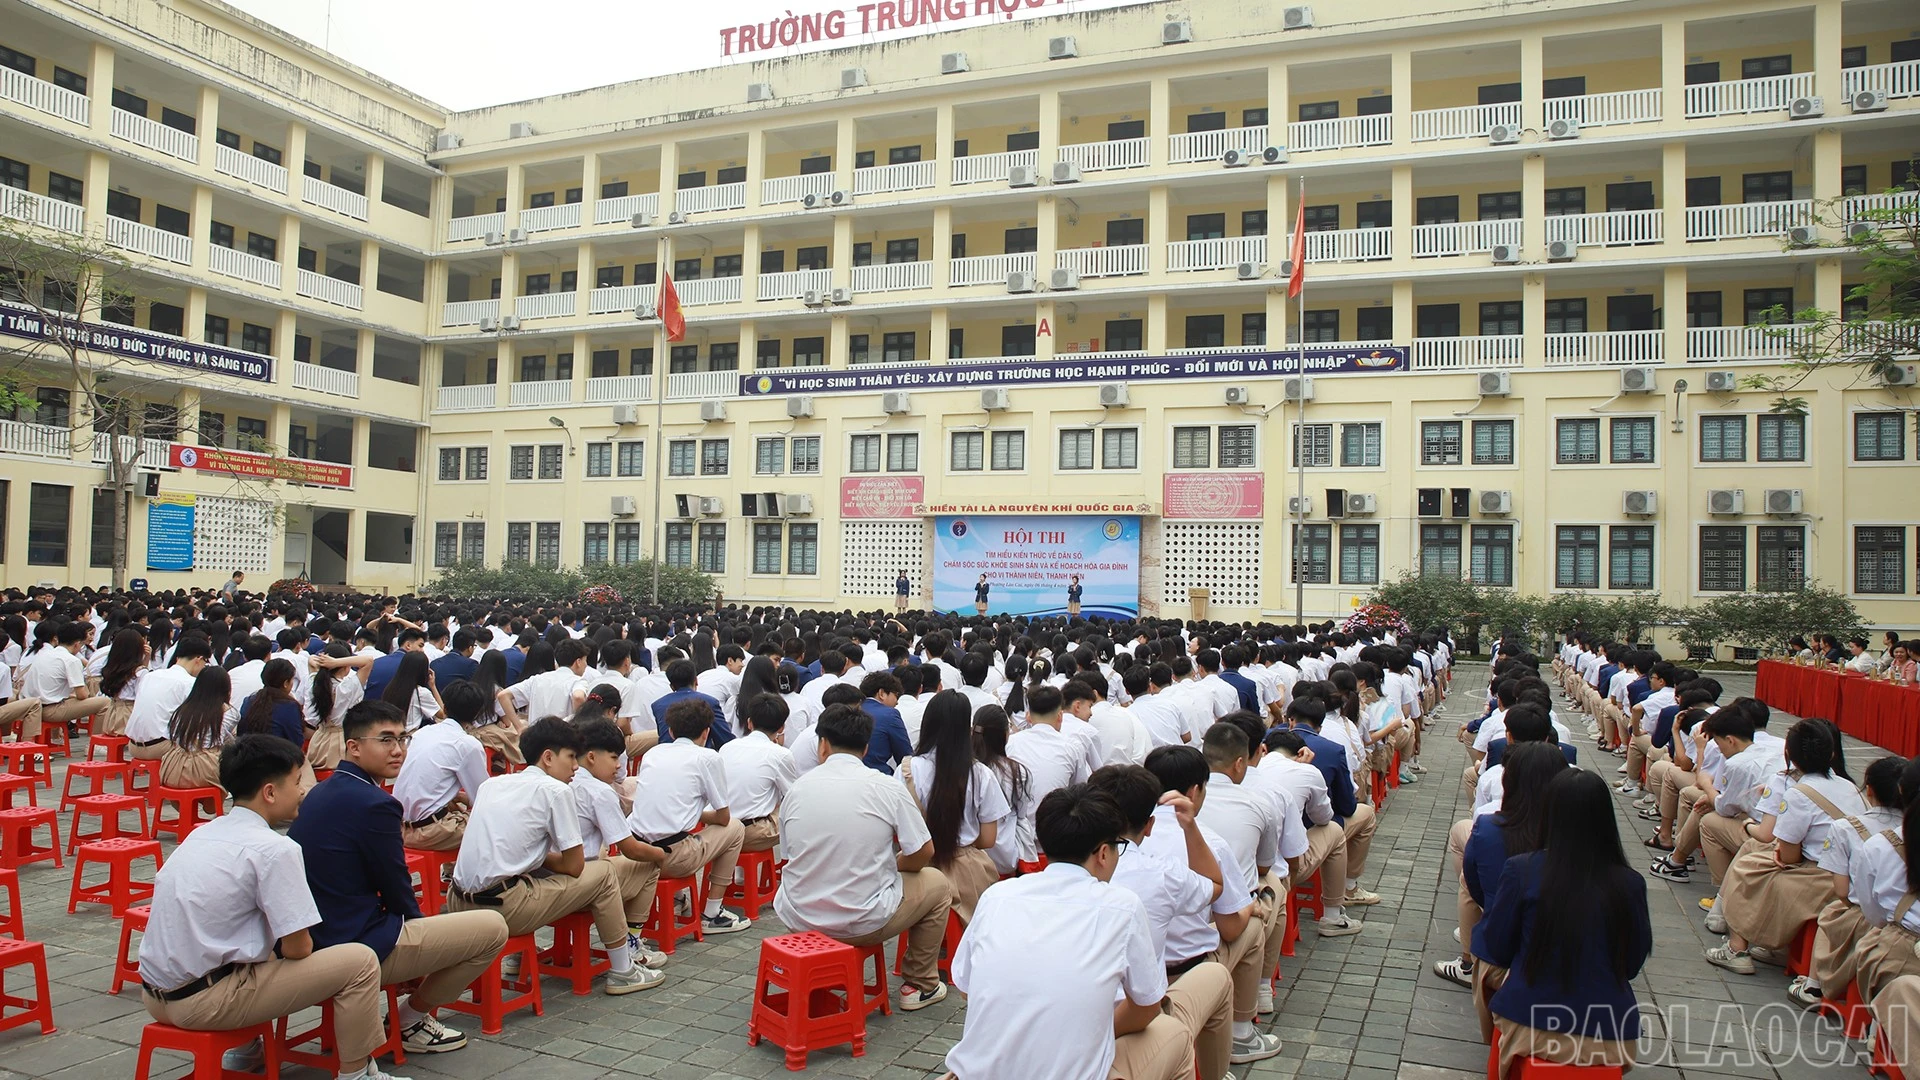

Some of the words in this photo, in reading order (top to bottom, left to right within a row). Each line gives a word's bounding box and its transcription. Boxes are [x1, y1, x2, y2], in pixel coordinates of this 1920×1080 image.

[720, 10, 845, 56] TRƯỜNG
[857, 0, 966, 34] TRUNG
[1037, 318, 1052, 337] A
[8, 315, 39, 334] TẤM
[93, 332, 119, 349] ĐẠO
[122, 338, 148, 354] ĐỨC
[150, 343, 167, 359] TỰ
[168, 347, 191, 363] HỌC
[193, 351, 208, 365] VÀ
[210, 355, 240, 371] SÁNG
[242, 361, 262, 376] TẠO
[800, 378, 823, 391] HỌC
[827, 377, 857, 388] SINH
[860, 374, 892, 386] THÂN
[896, 372, 924, 385] YÊU:
[927, 371, 953, 383] XÂY
[956, 370, 993, 384] DỰNG
[997, 366, 1051, 380] TRƯỜNG
[1055, 367, 1083, 380] HỌC
[1087, 365, 1127, 378] HẠNH
[1130, 362, 1170, 375] PHÚC
[1184, 358, 1210, 373] ĐỔI
[1214, 357, 1244, 372] MỚI
[1248, 358, 1268, 371] VÀ
[1272, 357, 1298, 372] HỘI
[960, 504, 978, 512] TÀI
[982, 504, 997, 512] LÀ
[999, 504, 1048, 512] NGUYÊN
[1051, 504, 1072, 512] KHÍ
[1076, 502, 1109, 512] QUỐC
[1004, 528, 1033, 547] HỘI
[1038, 531, 1065, 544] THI
[1030, 550, 1047, 559] THỨC
